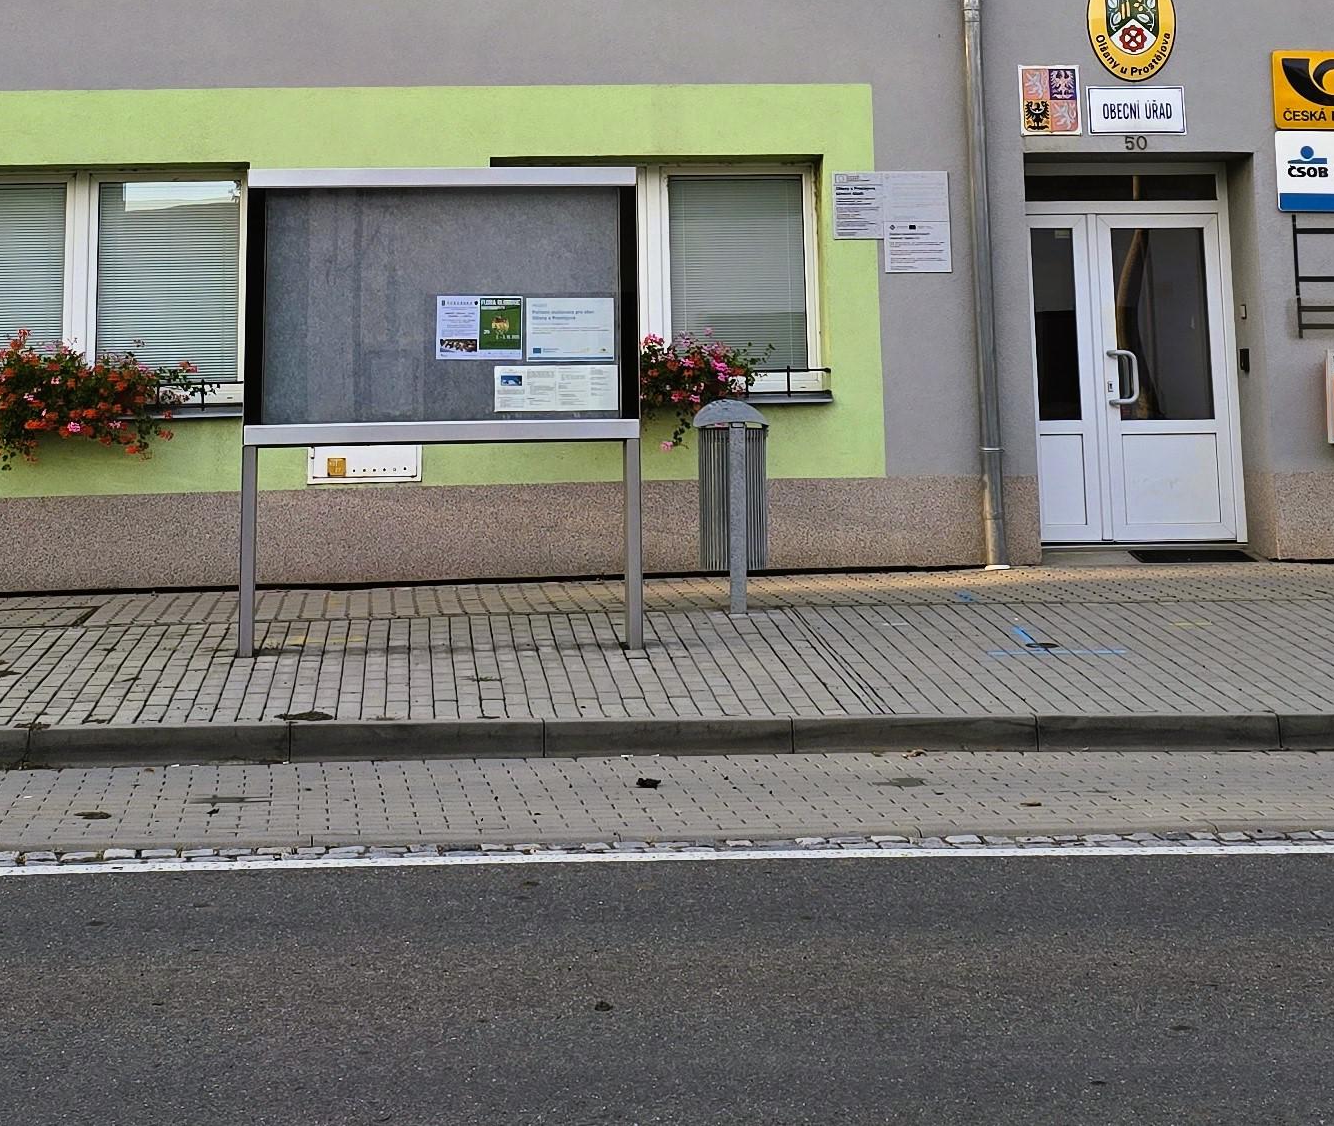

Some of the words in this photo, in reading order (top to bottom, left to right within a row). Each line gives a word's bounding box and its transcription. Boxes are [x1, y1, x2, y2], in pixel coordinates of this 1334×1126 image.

[1095, 34, 1120, 69] Olšany
[1120, 67, 1128, 75] u
[1130, 32, 1171, 76] Prostějova
[1102, 99, 1140, 120] OBECNÍ
[1144, 99, 1173, 120] ÚŘAD
[1282, 107, 1327, 122] ČESKÁ
[1124, 135, 1148, 151] 50
[1287, 164, 1329, 178] ČSOB
